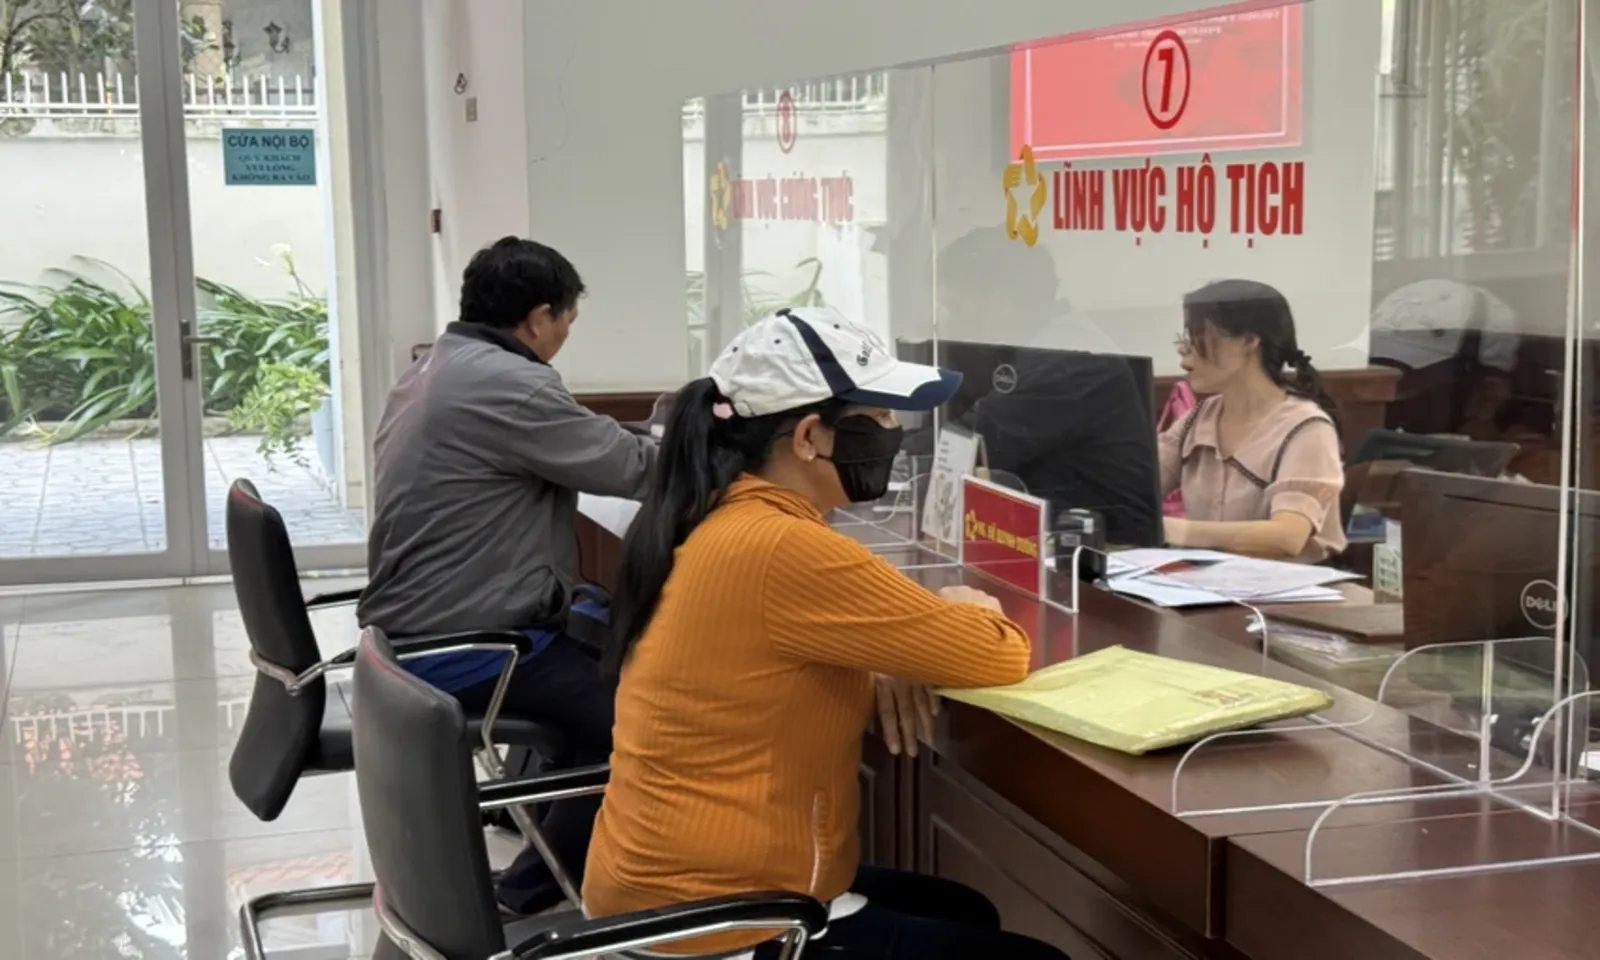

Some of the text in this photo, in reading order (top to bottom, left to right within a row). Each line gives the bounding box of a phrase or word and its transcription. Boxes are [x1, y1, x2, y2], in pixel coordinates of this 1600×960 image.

[227, 131, 310, 151] CỬA NỘI BỘ
[1053, 152, 1304, 249] LĨNH VỰC HỘ TỊCH
